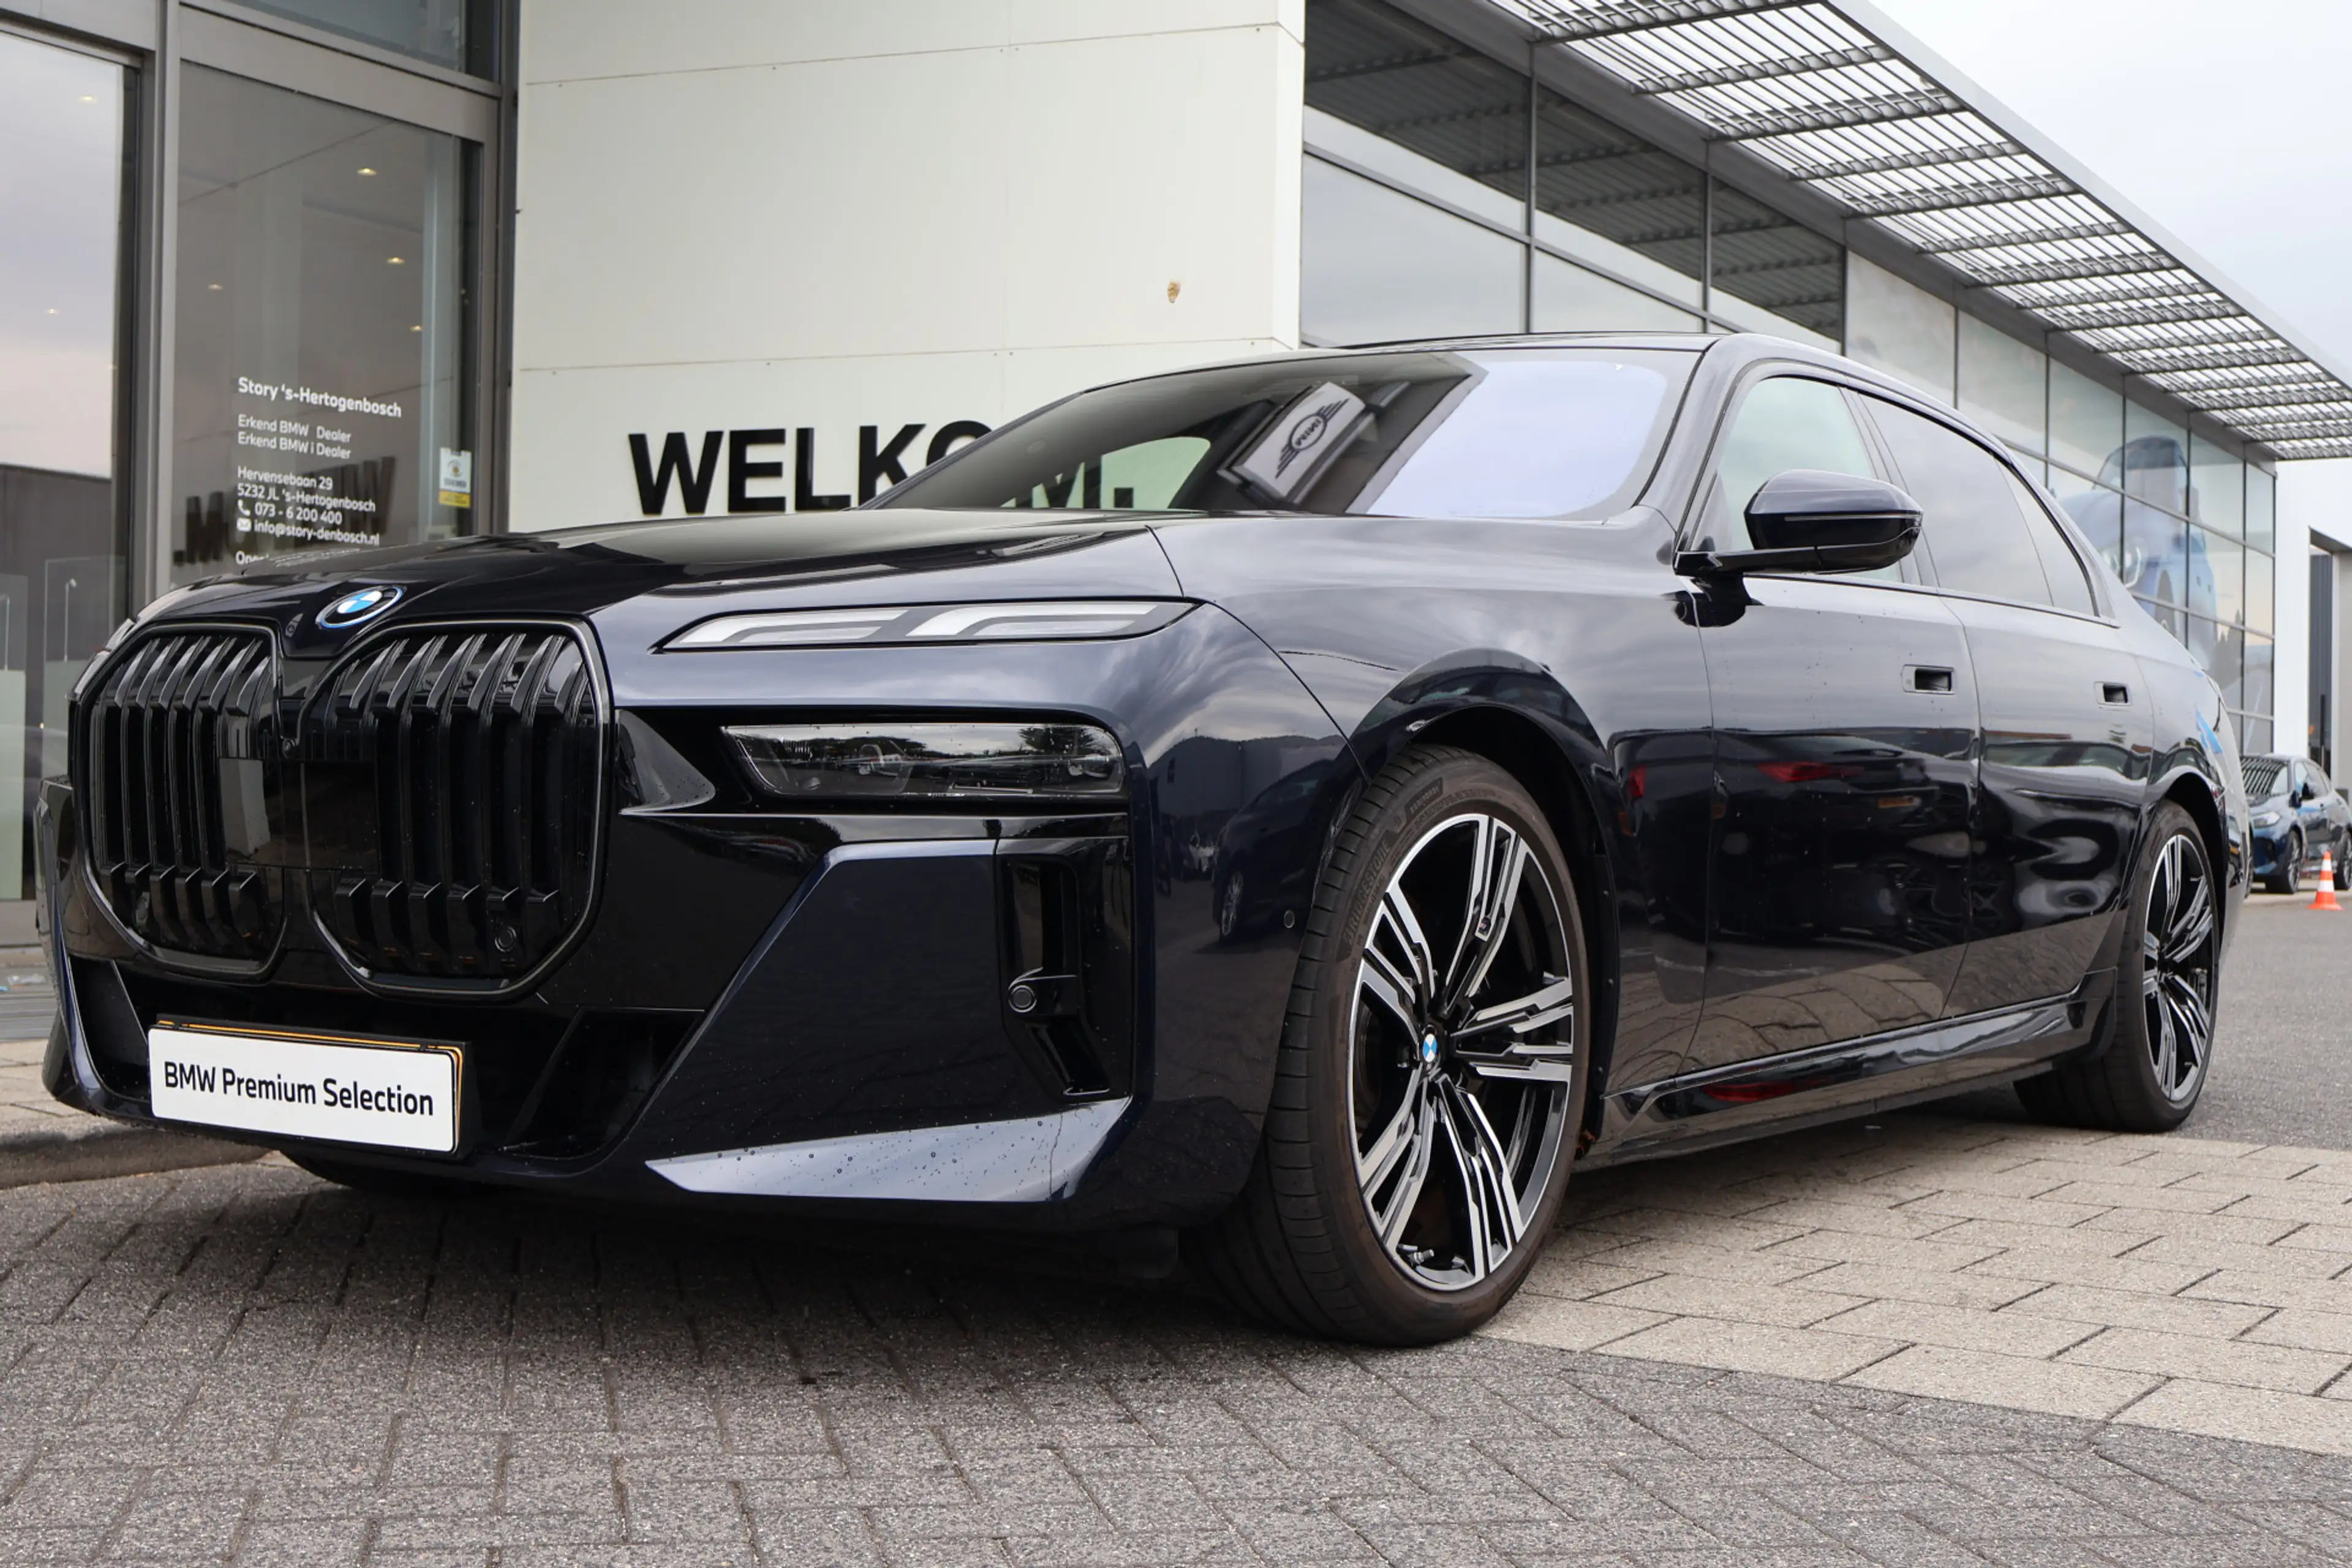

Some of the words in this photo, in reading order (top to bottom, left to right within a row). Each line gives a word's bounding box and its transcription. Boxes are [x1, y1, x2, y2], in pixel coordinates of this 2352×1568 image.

[238, 376, 278, 401] Story
[238, 414, 276, 432] Erkend
[279, 420, 309, 437] BMW
[316, 426, 352, 443] Dealer
[238, 431, 276, 449] Erkend
[279, 437, 309, 453] BMW
[311, 442, 314, 454] i
[316, 442, 351, 459] Dealer
[237, 483, 265, 500] 5232
[267, 488, 279, 500] JL
[238, 466, 317, 488] Hervensebaan
[318, 477, 333, 491] 29
[254, 502, 276, 518] 073
[286, 508, 292, 519] 6
[296, 508, 318, 522] 200
[320, 511, 342, 525] 400
[254, 519, 380, 546] info@story-denbosch.nl
[164, 1061, 216, 1093] BMW
[222, 1068, 316, 1105] Premium
[323, 1077, 434, 1116] Selection
